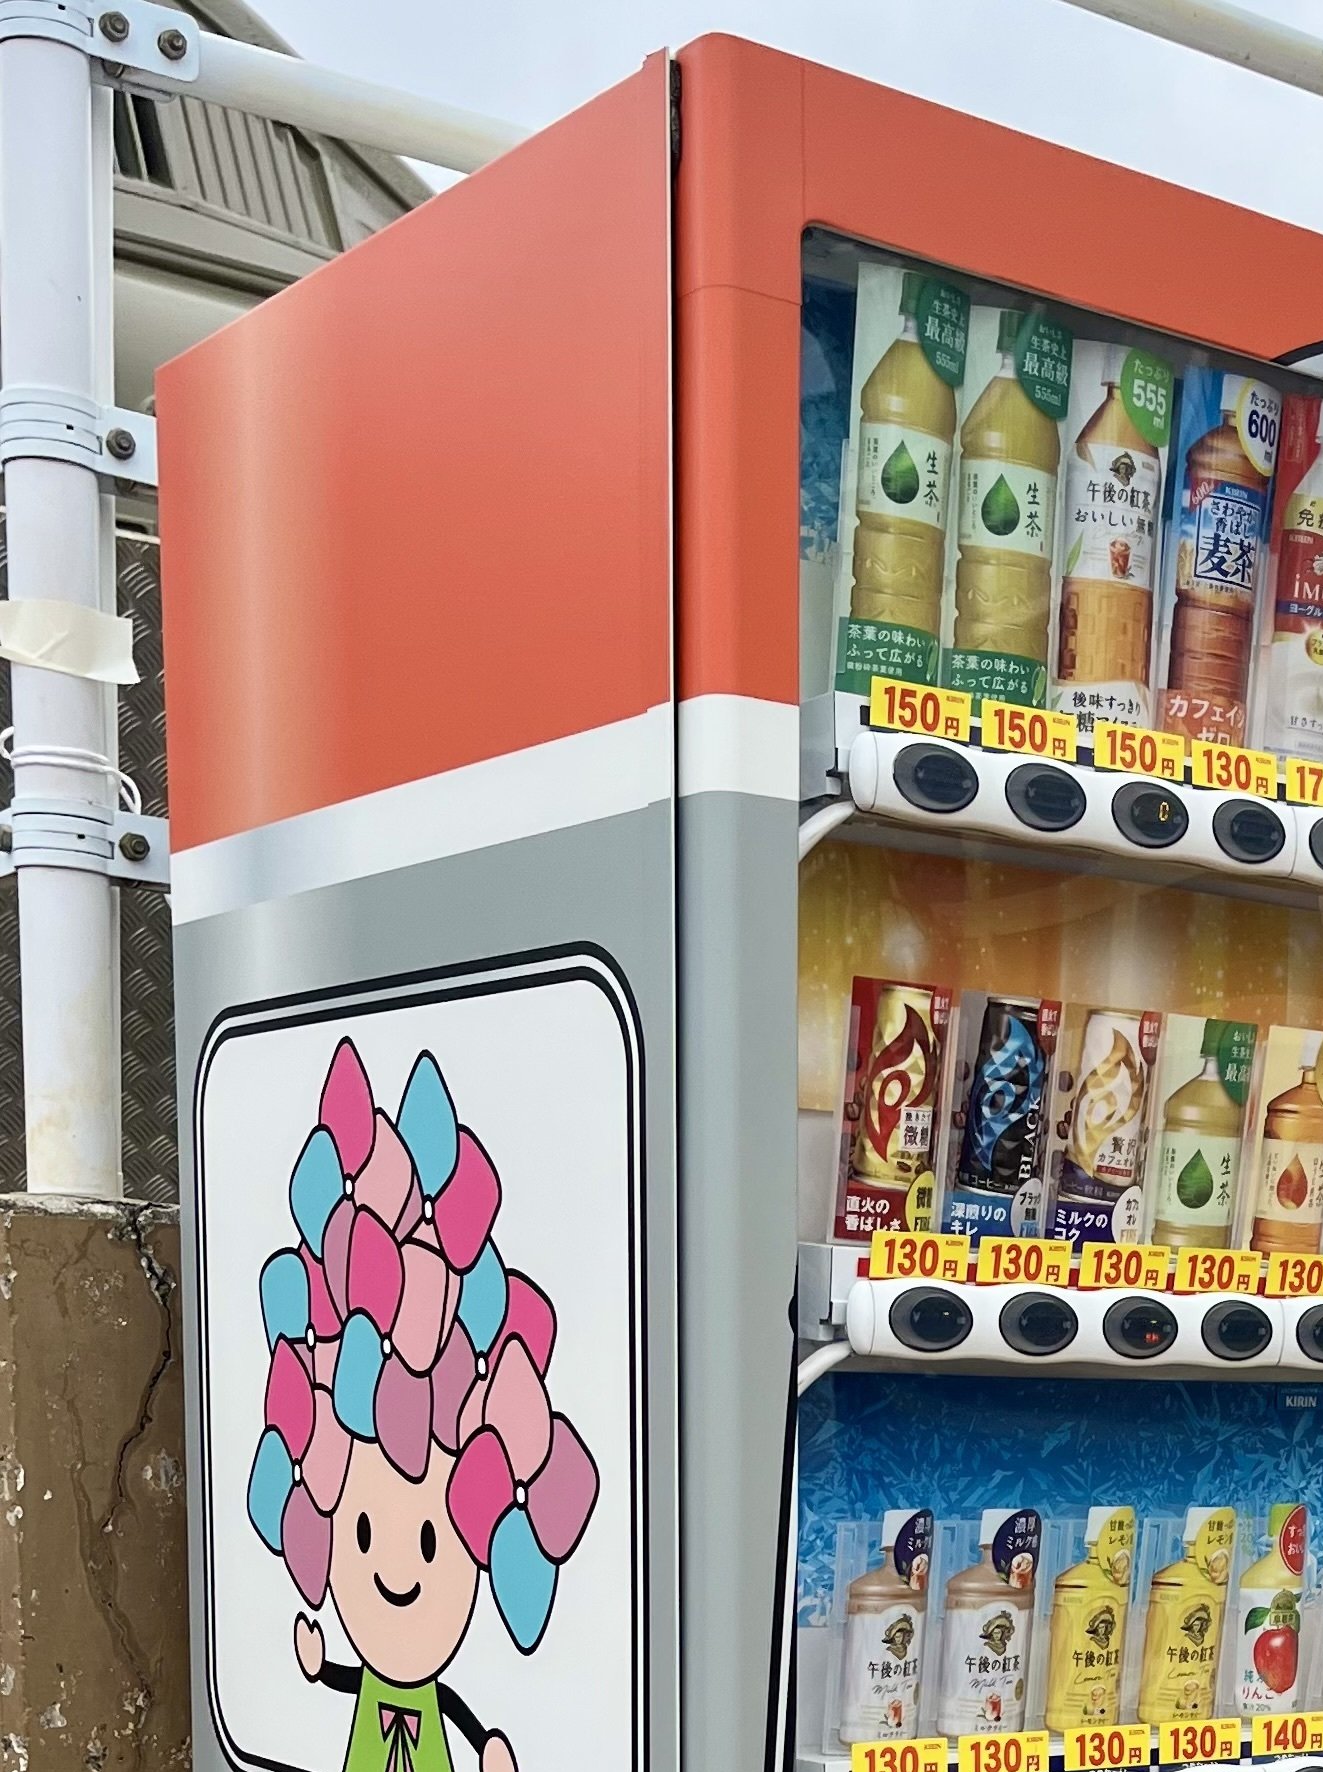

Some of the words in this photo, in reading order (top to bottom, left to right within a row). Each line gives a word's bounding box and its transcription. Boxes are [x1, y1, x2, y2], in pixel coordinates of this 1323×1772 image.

[924, 315, 966, 356] 最高級
[1023, 351, 1069, 388] 最高級
[1132, 380, 1167, 416] 555
[1247, 409, 1276, 448] 600
[923, 449, 939, 509] 生茶
[1086, 480, 1153, 515] 午後の紅茶
[1025, 481, 1042, 539] 生茶
[1199, 532, 1255, 584] 麦茶
[847, 624, 926, 650] 茶葉の味わい
[847, 643, 924, 669] ふって広がる
[952, 654, 1031, 676] 茶葉の味わい
[952, 673, 1029, 695] ふって広がる
[884, 686, 960, 738] 150円
[994, 708, 1067, 758] 150円
[1106, 729, 1175, 778] 150円
[1202, 748, 1269, 794] 130円
[1018, 1096, 1041, 1180] BLACK
[1219, 1152, 1233, 1208] 生茶
[950, 1220, 978, 1235] キレ
[1053, 1226, 1081, 1243] コク
[1056, 1208, 1108, 1228] ミルクの
[884, 1238, 958, 1278] 130円
[991, 1243, 1061, 1283] 130円
[1092, 1249, 1160, 1287] 130円
[1188, 1254, 1251, 1292] 130円
[1014, 1515, 1037, 1535] 濃厚
[965, 1654, 1022, 1675] 午後の紅茶
[1076, 1731, 1142, 1768] 130円
[1170, 1725, 1233, 1760] 130円
[1263, 1717, 1323, 1752] 140円
